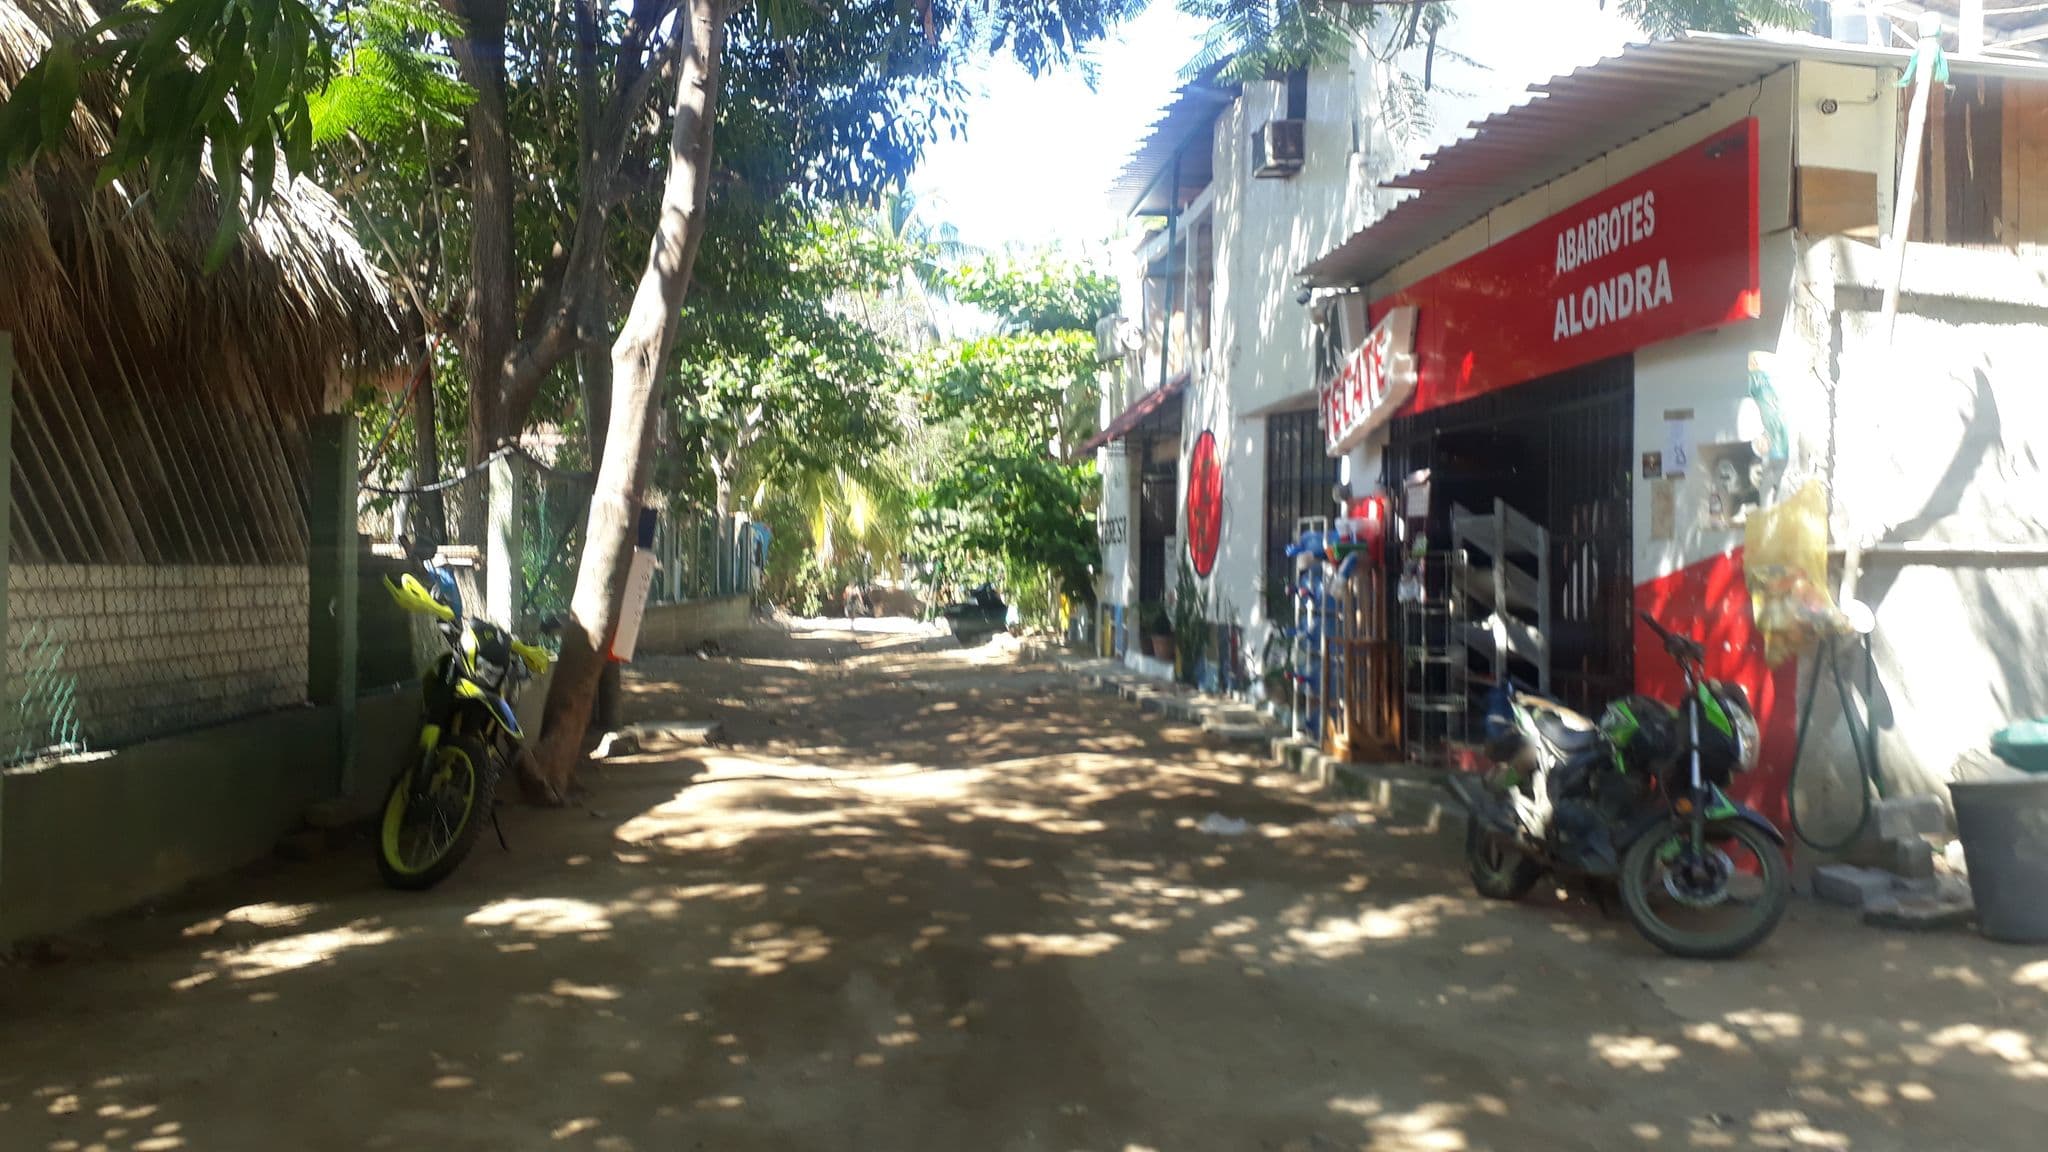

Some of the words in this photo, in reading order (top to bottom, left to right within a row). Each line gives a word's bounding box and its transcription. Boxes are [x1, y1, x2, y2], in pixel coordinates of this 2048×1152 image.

[1556, 190, 1656, 276] ABARROTES
[1553, 258, 1673, 342] ALONDRA
[1321, 324, 1387, 445] TECATE
